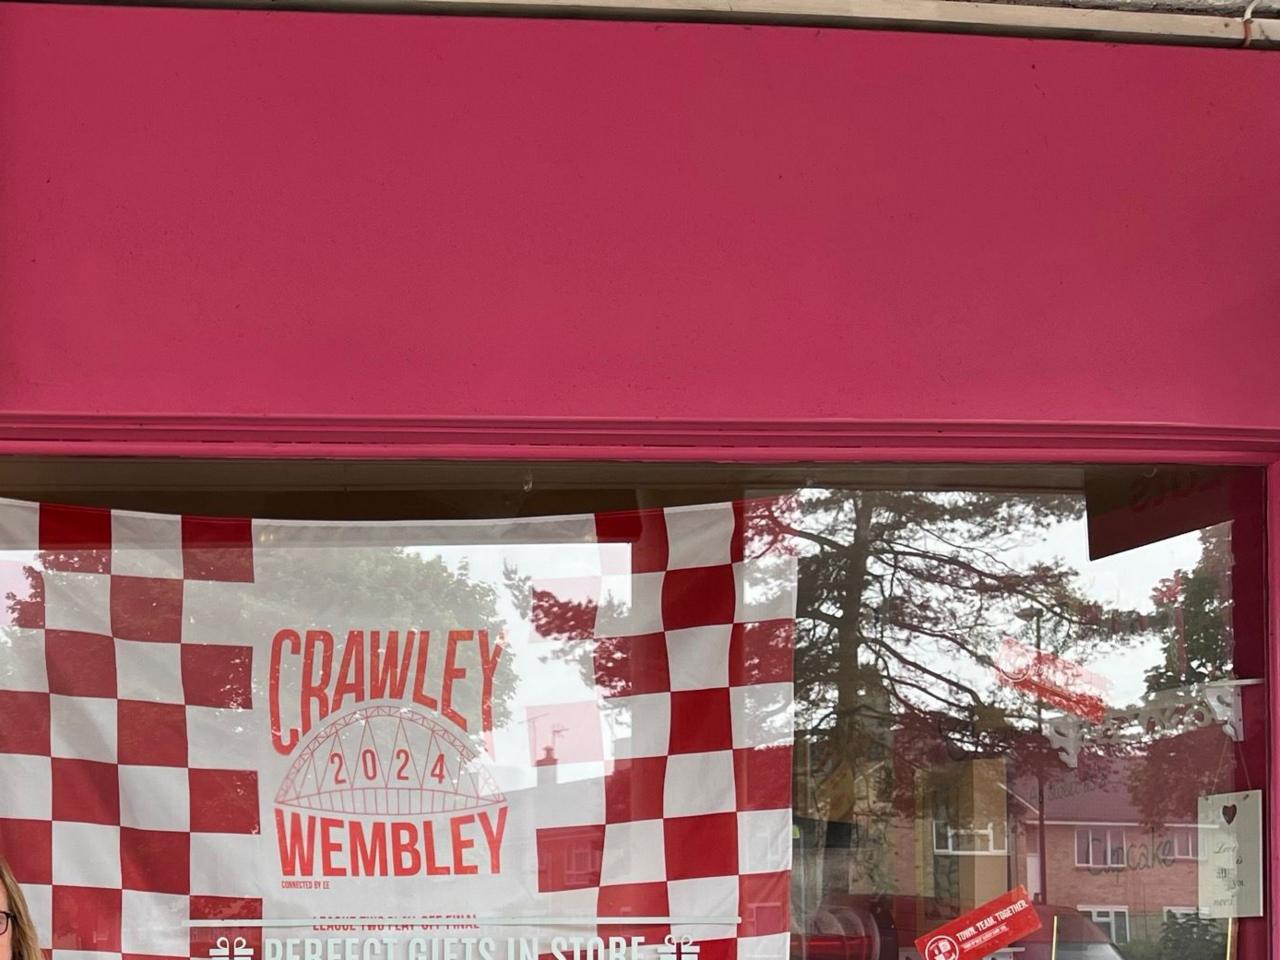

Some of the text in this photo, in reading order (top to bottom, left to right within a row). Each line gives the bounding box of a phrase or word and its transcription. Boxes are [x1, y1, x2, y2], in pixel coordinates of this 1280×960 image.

[269, 628, 504, 758] CRAWLEY
[330, 749, 445, 784] 2024
[274, 806, 508, 877] WEMBLEY
